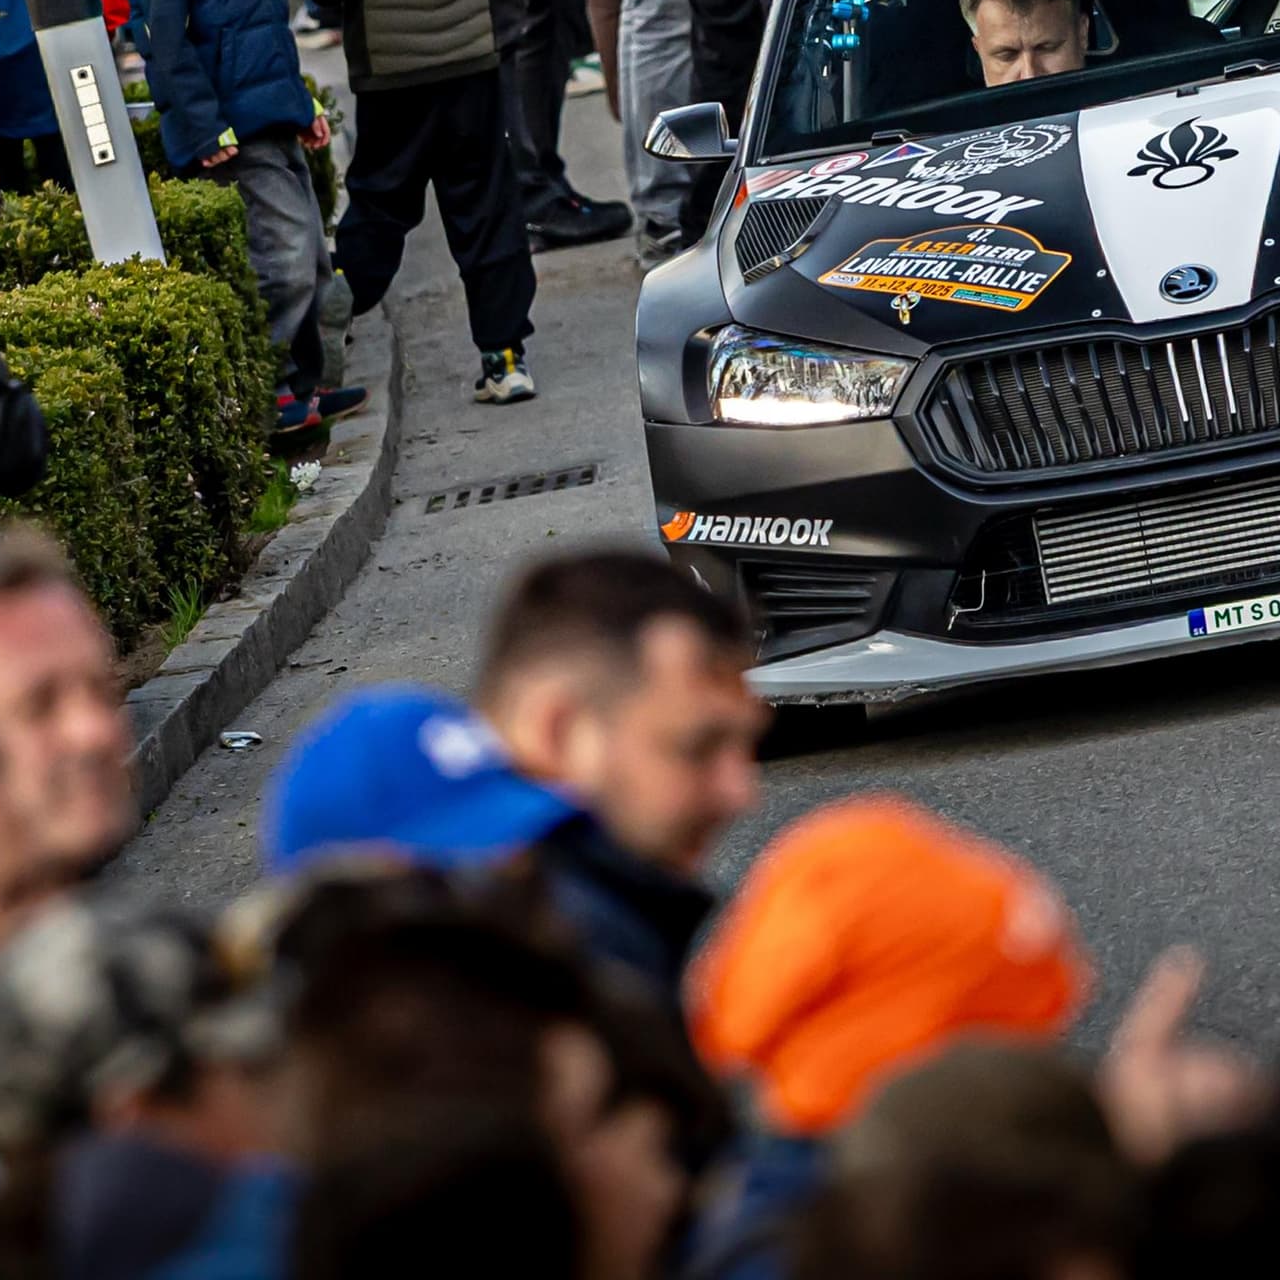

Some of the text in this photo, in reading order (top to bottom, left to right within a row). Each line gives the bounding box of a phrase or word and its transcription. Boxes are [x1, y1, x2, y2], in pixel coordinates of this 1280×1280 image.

[966, 228, 989, 243] 47.
[840, 257, 1048, 294] LAVANTTAL-RALLYE
[1214, 606, 1244, 628] MT
[1250, 603, 1264, 621] S
